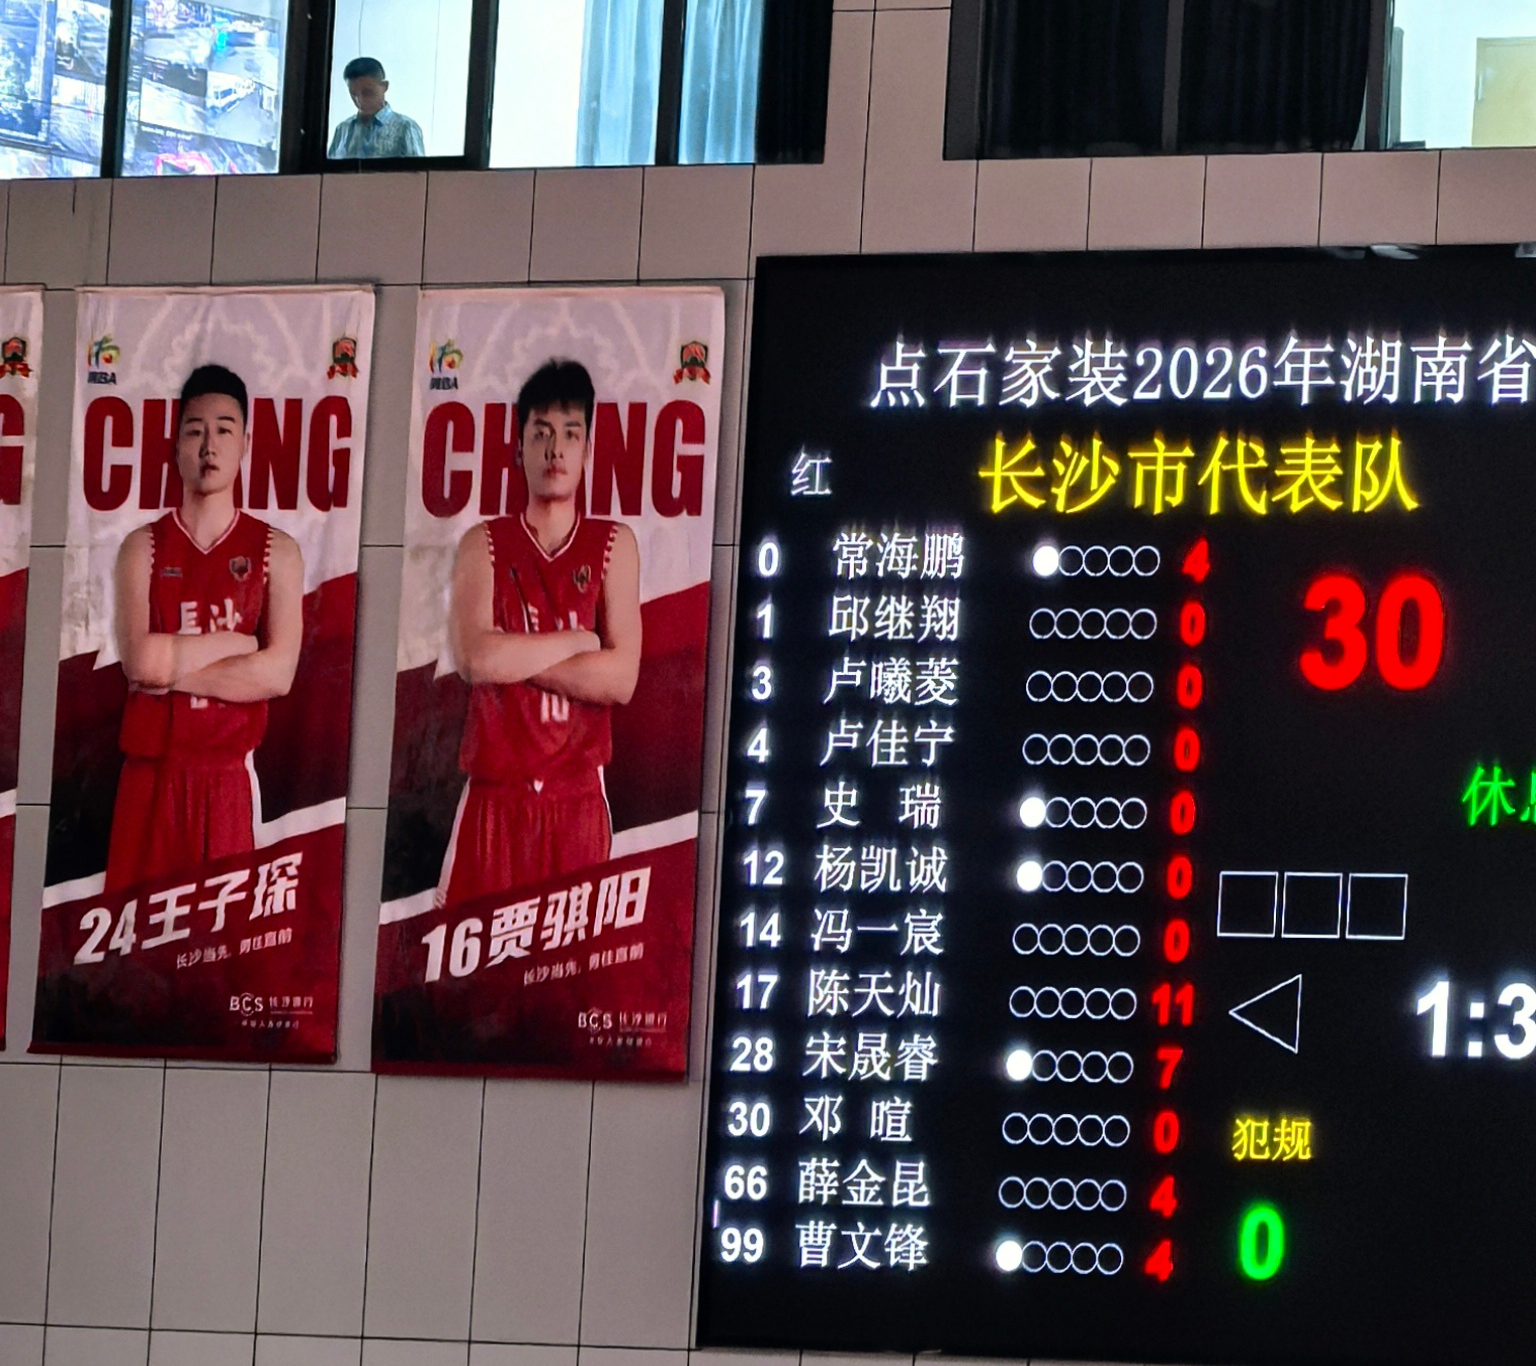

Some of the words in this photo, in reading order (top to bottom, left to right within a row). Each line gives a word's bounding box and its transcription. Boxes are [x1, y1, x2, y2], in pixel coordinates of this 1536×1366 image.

[83, 395, 353, 512] CHNG
[421, 399, 706, 518] CHNG
[791, 452, 831, 495] 红
[978, 436, 1419, 515] 长沙市代表队
[758, 541, 780, 577] 0
[832, 532, 965, 580] 常海鹏
[1182, 539, 1210, 582] 4
[756, 602, 772, 639] 1
[828, 595, 961, 642] 邱继翔
[1180, 601, 1206, 646] 0
[1300, 574, 1444, 690] 30
[751, 665, 772, 700] 3
[823, 657, 959, 706] 卢曦菱
[1177, 664, 1203, 709] 0
[747, 727, 770, 763] 4
[820, 721, 954, 767] 卢佳宁
[1174, 727, 1200, 771] 0
[745, 788, 767, 825] 7
[1170, 790, 1196, 834] 0
[743, 849, 785, 885] 12
[814, 844, 948, 893] 杨凯诚
[1167, 856, 1193, 899] 0
[740, 911, 782, 948] 14
[810, 908, 944, 955] 冯一宸
[1163, 919, 1190, 962] 0
[229, 993, 264, 1015] BCS
[736, 973, 779, 1009] 17
[807, 968, 940, 1017] 陈天灿
[1152, 983, 1194, 1025] 11
[730, 1036, 774, 1072] 28
[803, 1031, 938, 1081] 宋晟睿
[1157, 1047, 1183, 1088] 7
[727, 1101, 771, 1137] 30
[1153, 1111, 1179, 1153] 0
[1231, 1117, 1312, 1162] 犯规
[724, 1164, 768, 1201] 66
[798, 1157, 930, 1207] 薛金昆
[1150, 1176, 1177, 1217] 4
[720, 1227, 764, 1263] 99
[795, 1220, 929, 1271] 曹文锋
[1145, 1240, 1174, 1281] 4
[1238, 1202, 1285, 1281] 0
